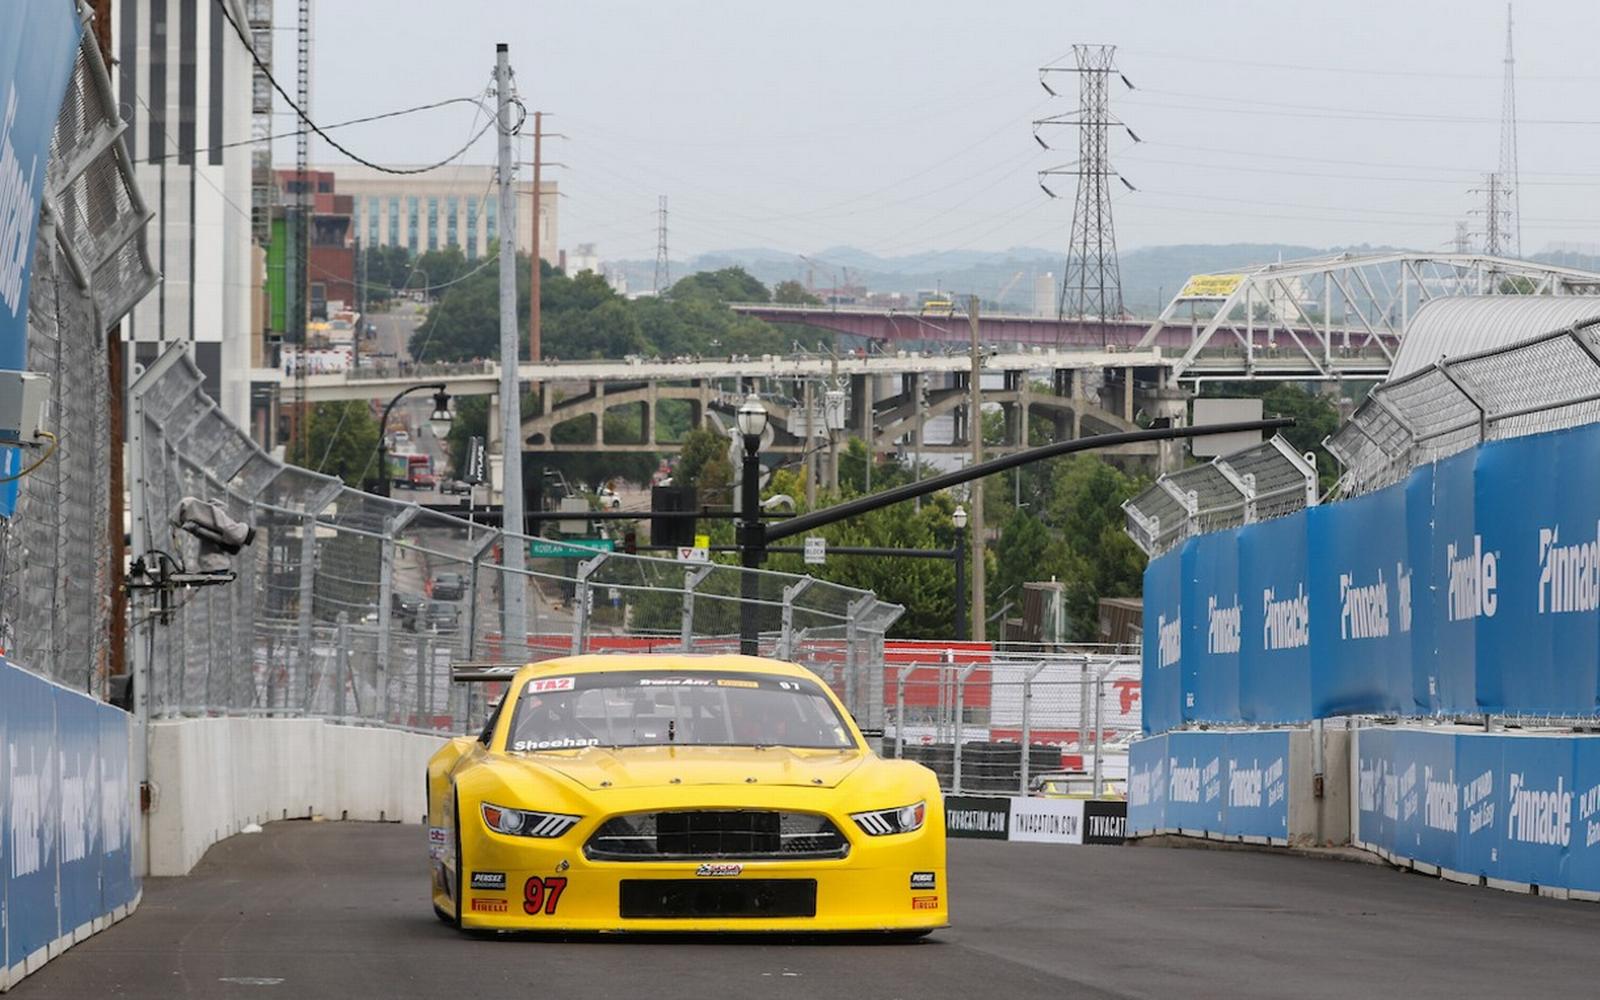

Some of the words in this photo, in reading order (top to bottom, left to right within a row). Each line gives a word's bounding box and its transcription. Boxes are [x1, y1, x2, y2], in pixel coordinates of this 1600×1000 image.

[1263, 582, 1308, 650] Pinnacle
[535, 680, 570, 691] TA2
[513, 738, 598, 751] Sheehan
[1509, 772, 1571, 847] Pinnacle
[1016, 813, 1078, 835] TNVACATION.COM
[1089, 816, 1127, 837] TNVACAT
[523, 876, 568, 915] 97
